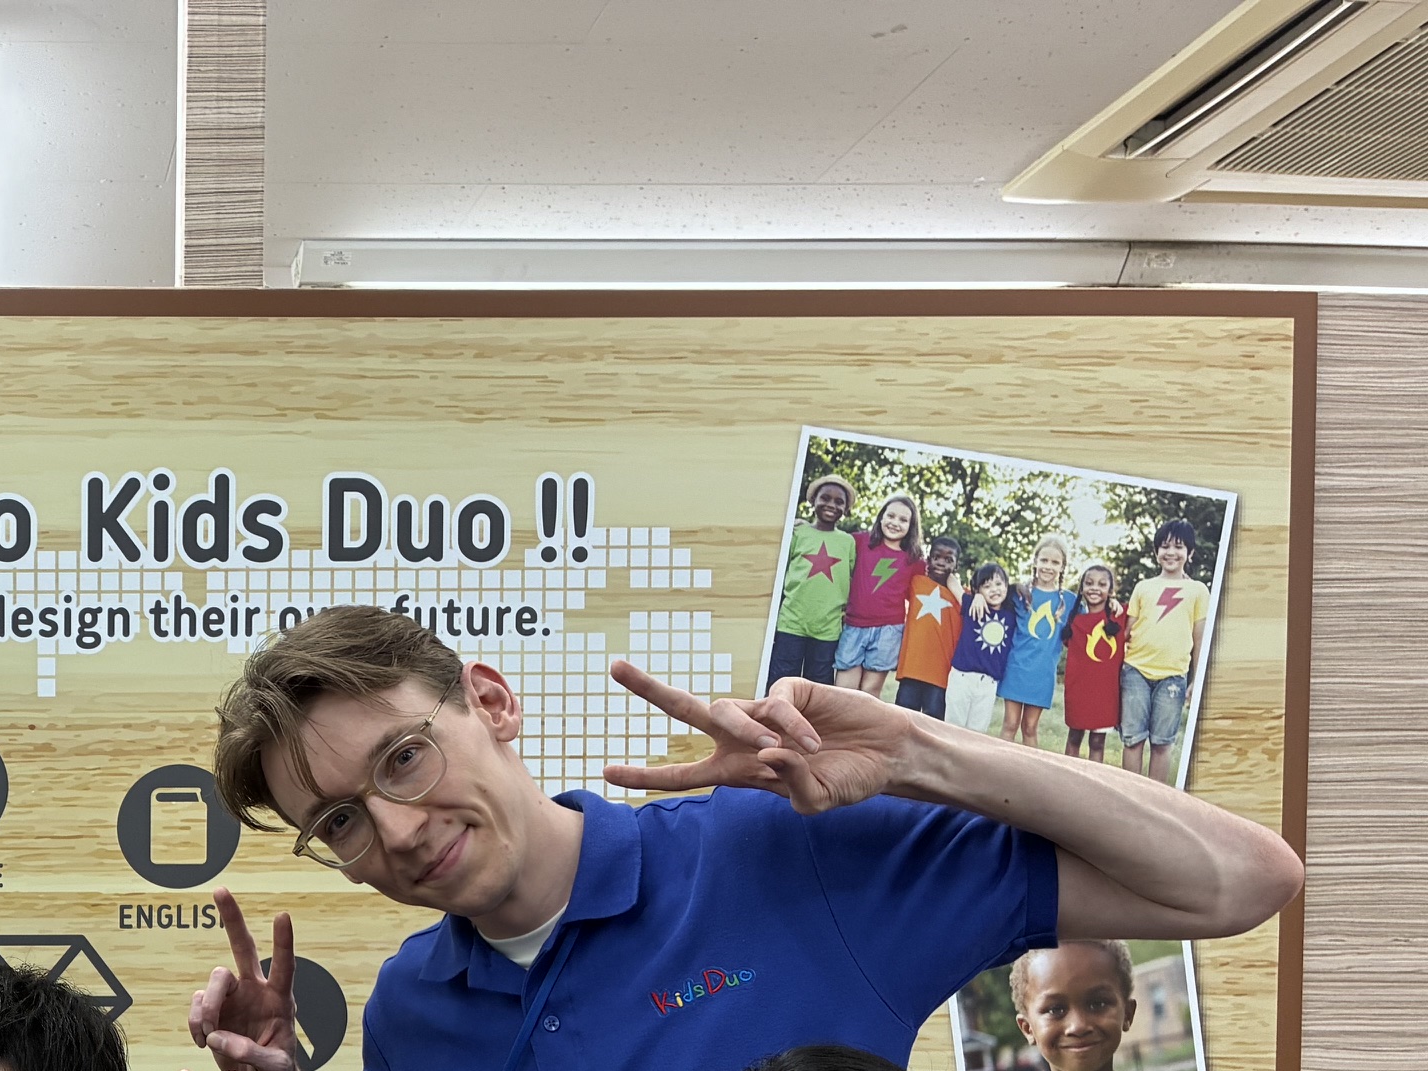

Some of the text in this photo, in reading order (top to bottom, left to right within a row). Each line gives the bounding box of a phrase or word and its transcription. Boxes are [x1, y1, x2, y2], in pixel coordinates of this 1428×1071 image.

[86, 473, 285, 563] Kids
[328, 477, 506, 563] Duo
[540, 477, 590, 563] !!
[149, 593, 261, 638] their
[119, 904, 225, 929] ENGLIS
